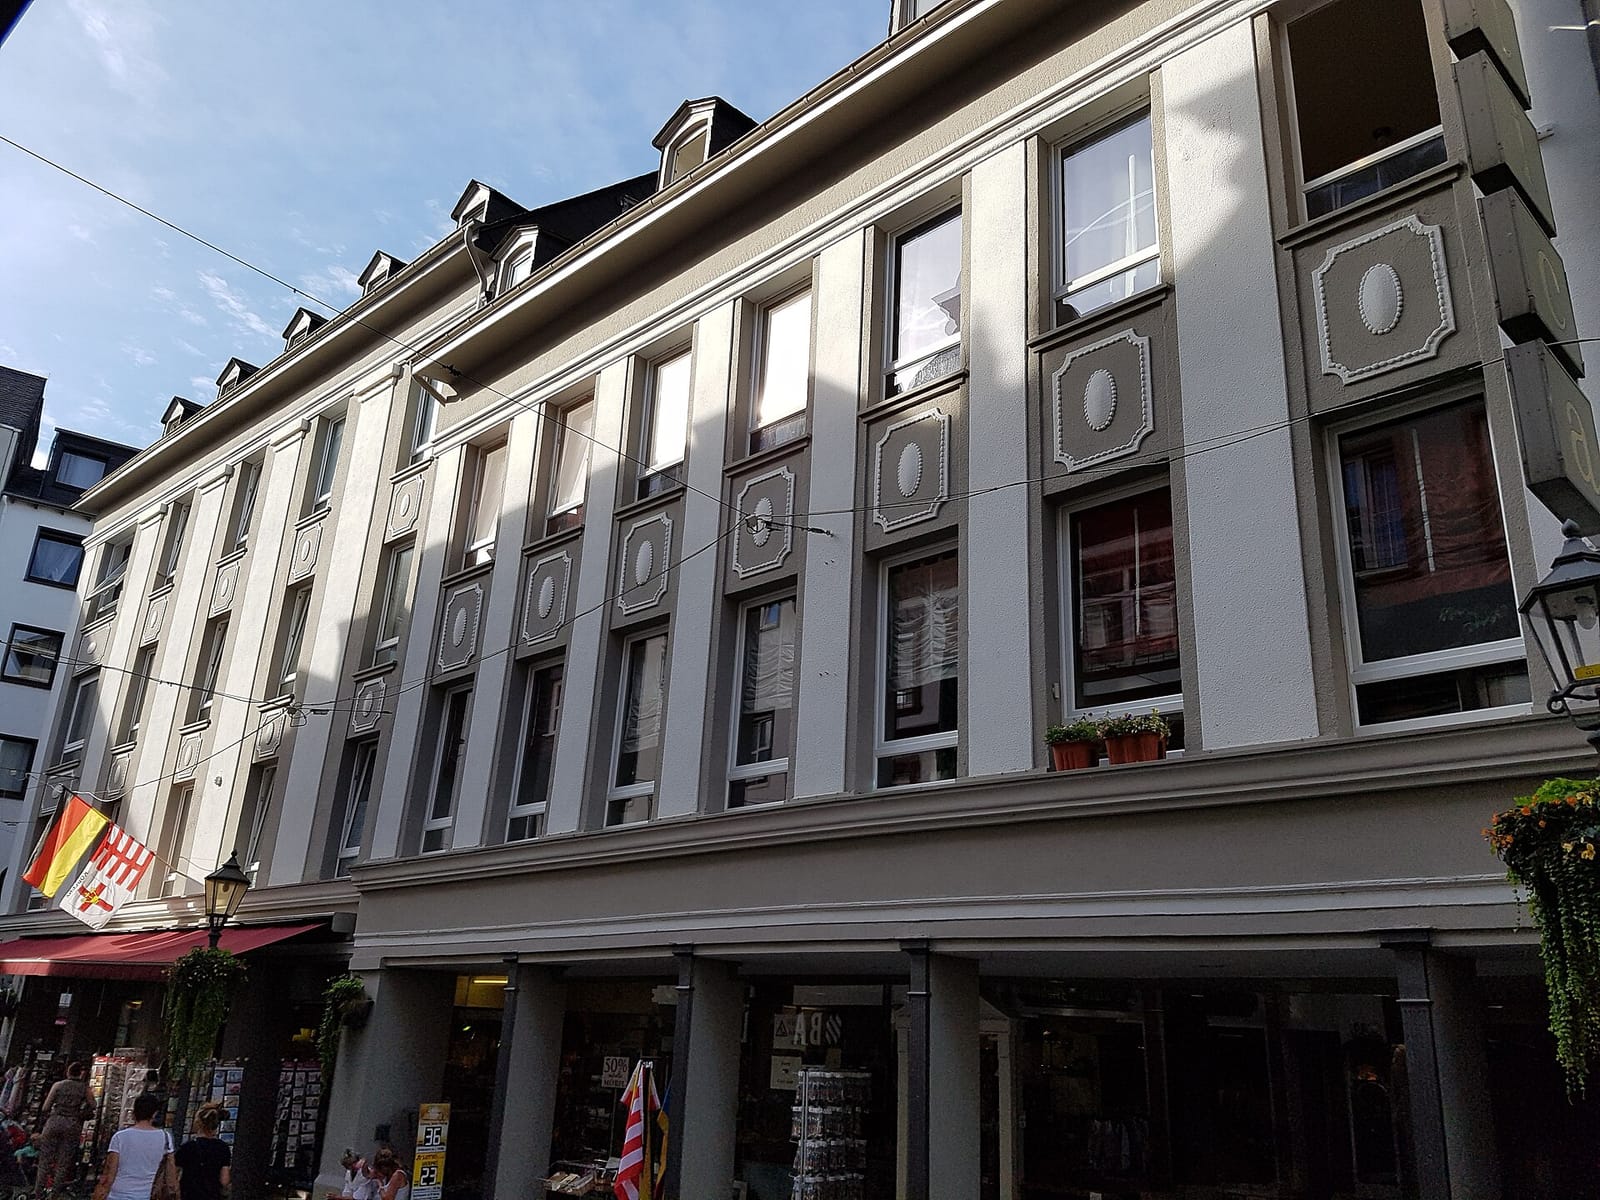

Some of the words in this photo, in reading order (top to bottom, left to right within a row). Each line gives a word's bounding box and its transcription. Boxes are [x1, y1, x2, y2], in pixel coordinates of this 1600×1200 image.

[604, 1058, 628, 1073] 50%
[425, 1127, 441, 1146] 36
[420, 1167, 437, 1186] 23
